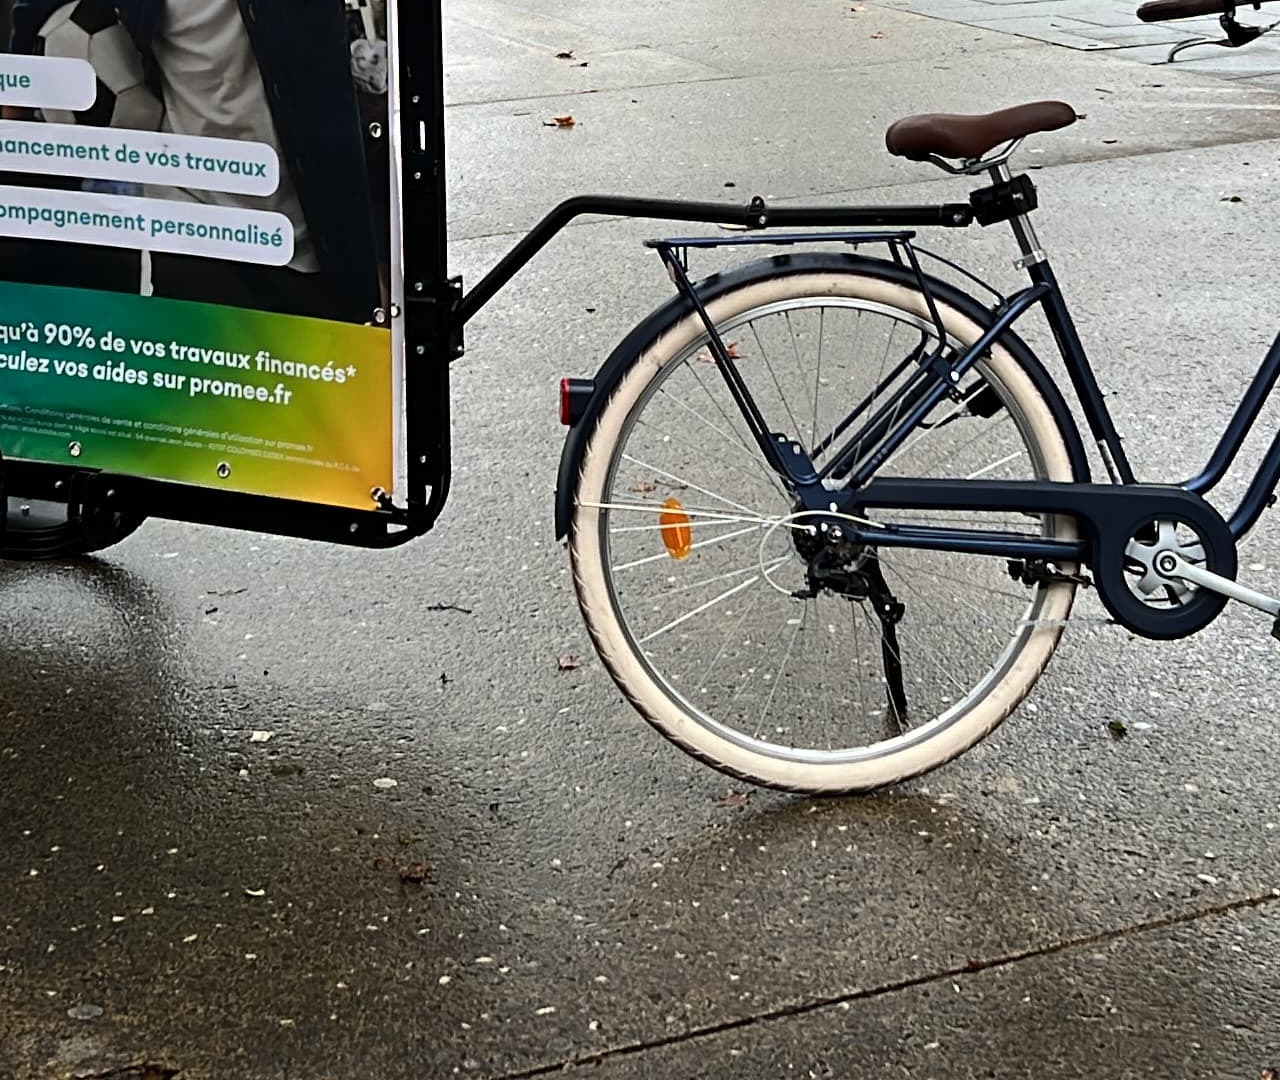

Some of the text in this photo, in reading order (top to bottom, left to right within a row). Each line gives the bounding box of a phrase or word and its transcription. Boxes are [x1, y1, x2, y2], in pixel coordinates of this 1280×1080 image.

[115, 143, 140, 164] de
[145, 150, 181, 168] vos
[184, 152, 267, 178] travaux
[151, 218, 284, 248] personnalisé
[43, 323, 97, 350] 90%
[99, 330, 127, 353] de
[130, 339, 166, 358] vos
[169, 341, 251, 370] travaux
[53, 360, 89, 378] vos
[92, 360, 149, 386] aides
[152, 372, 186, 391] sur
[190, 375, 293, 406] promee.fr
